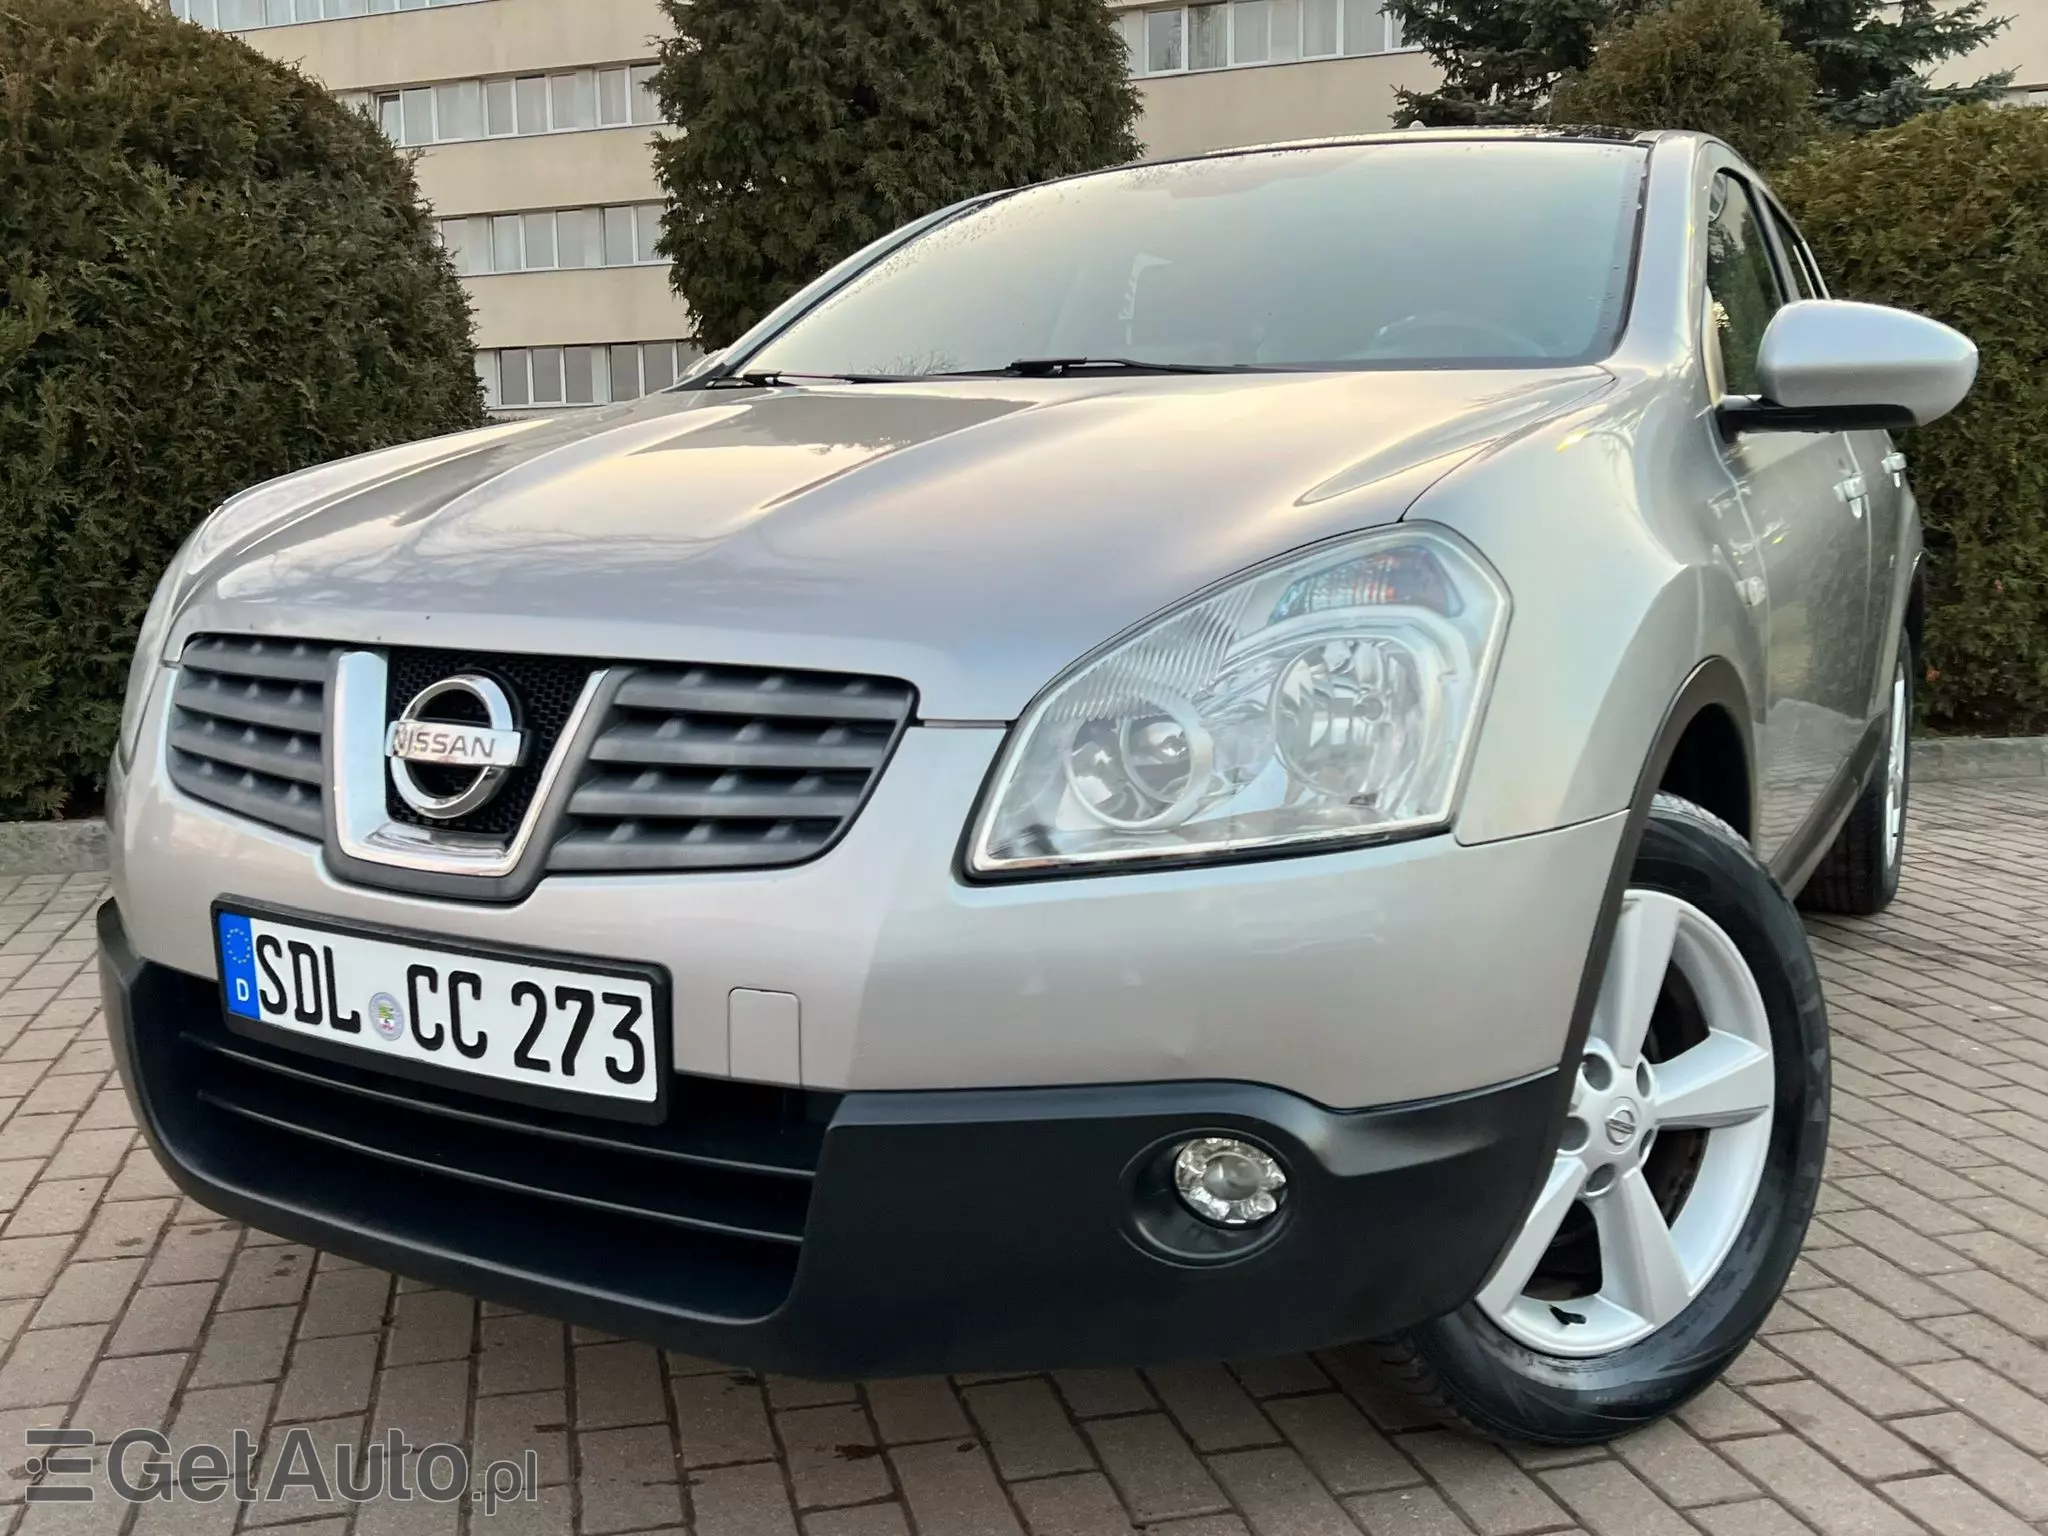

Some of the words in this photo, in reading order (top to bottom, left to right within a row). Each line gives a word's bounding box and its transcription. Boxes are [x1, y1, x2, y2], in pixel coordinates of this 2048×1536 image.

[392, 722, 496, 758] NISSAN
[235, 977, 250, 1002] D
[255, 934, 362, 1034] SDL
[406, 963, 489, 1060] CC
[510, 980, 647, 1085] 273
